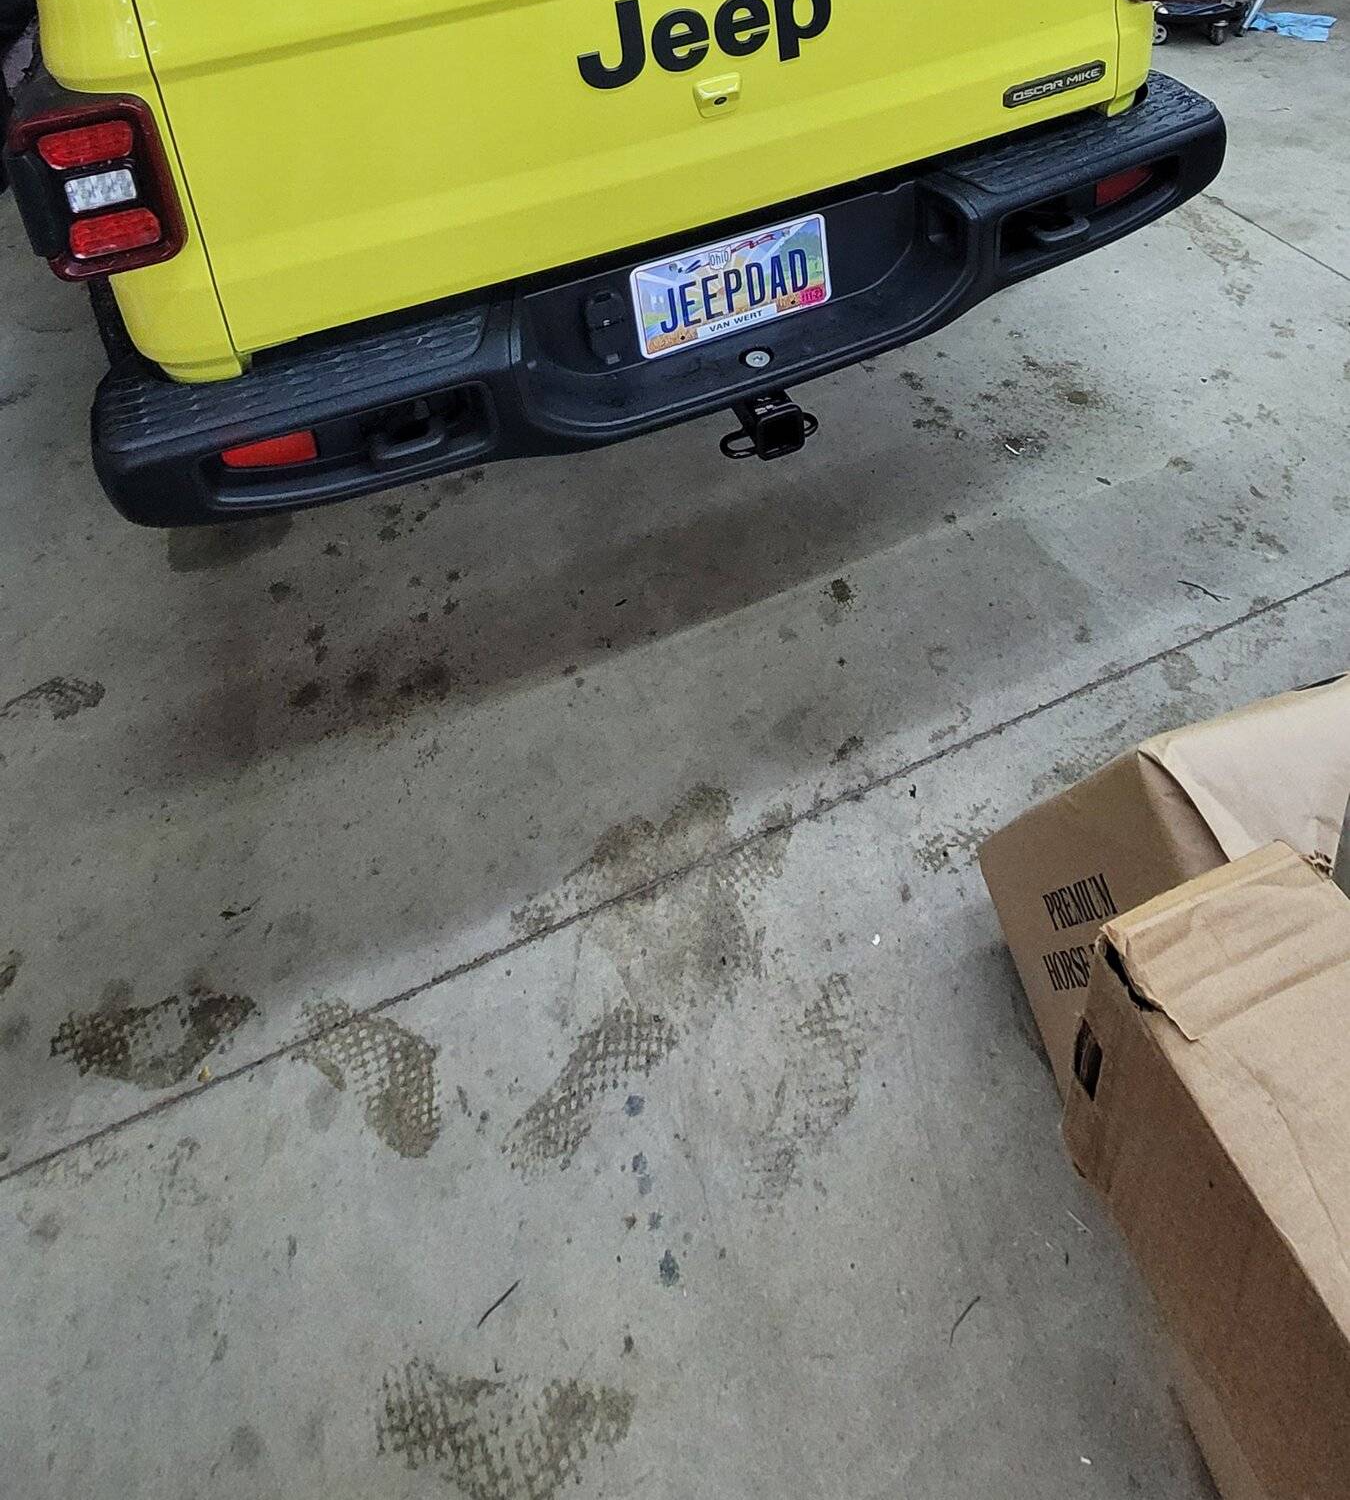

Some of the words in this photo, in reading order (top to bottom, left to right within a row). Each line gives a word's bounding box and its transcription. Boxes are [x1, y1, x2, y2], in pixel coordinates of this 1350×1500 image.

[1013, 80, 1063, 101] OSCAR
[1067, 67, 1100, 85] MIKE
[661, 249, 808, 333] JEEPDAD
[709, 318, 730, 332] VAN
[734, 310, 763, 325] WERT
[1042, 873, 1117, 931] PREMIUM
